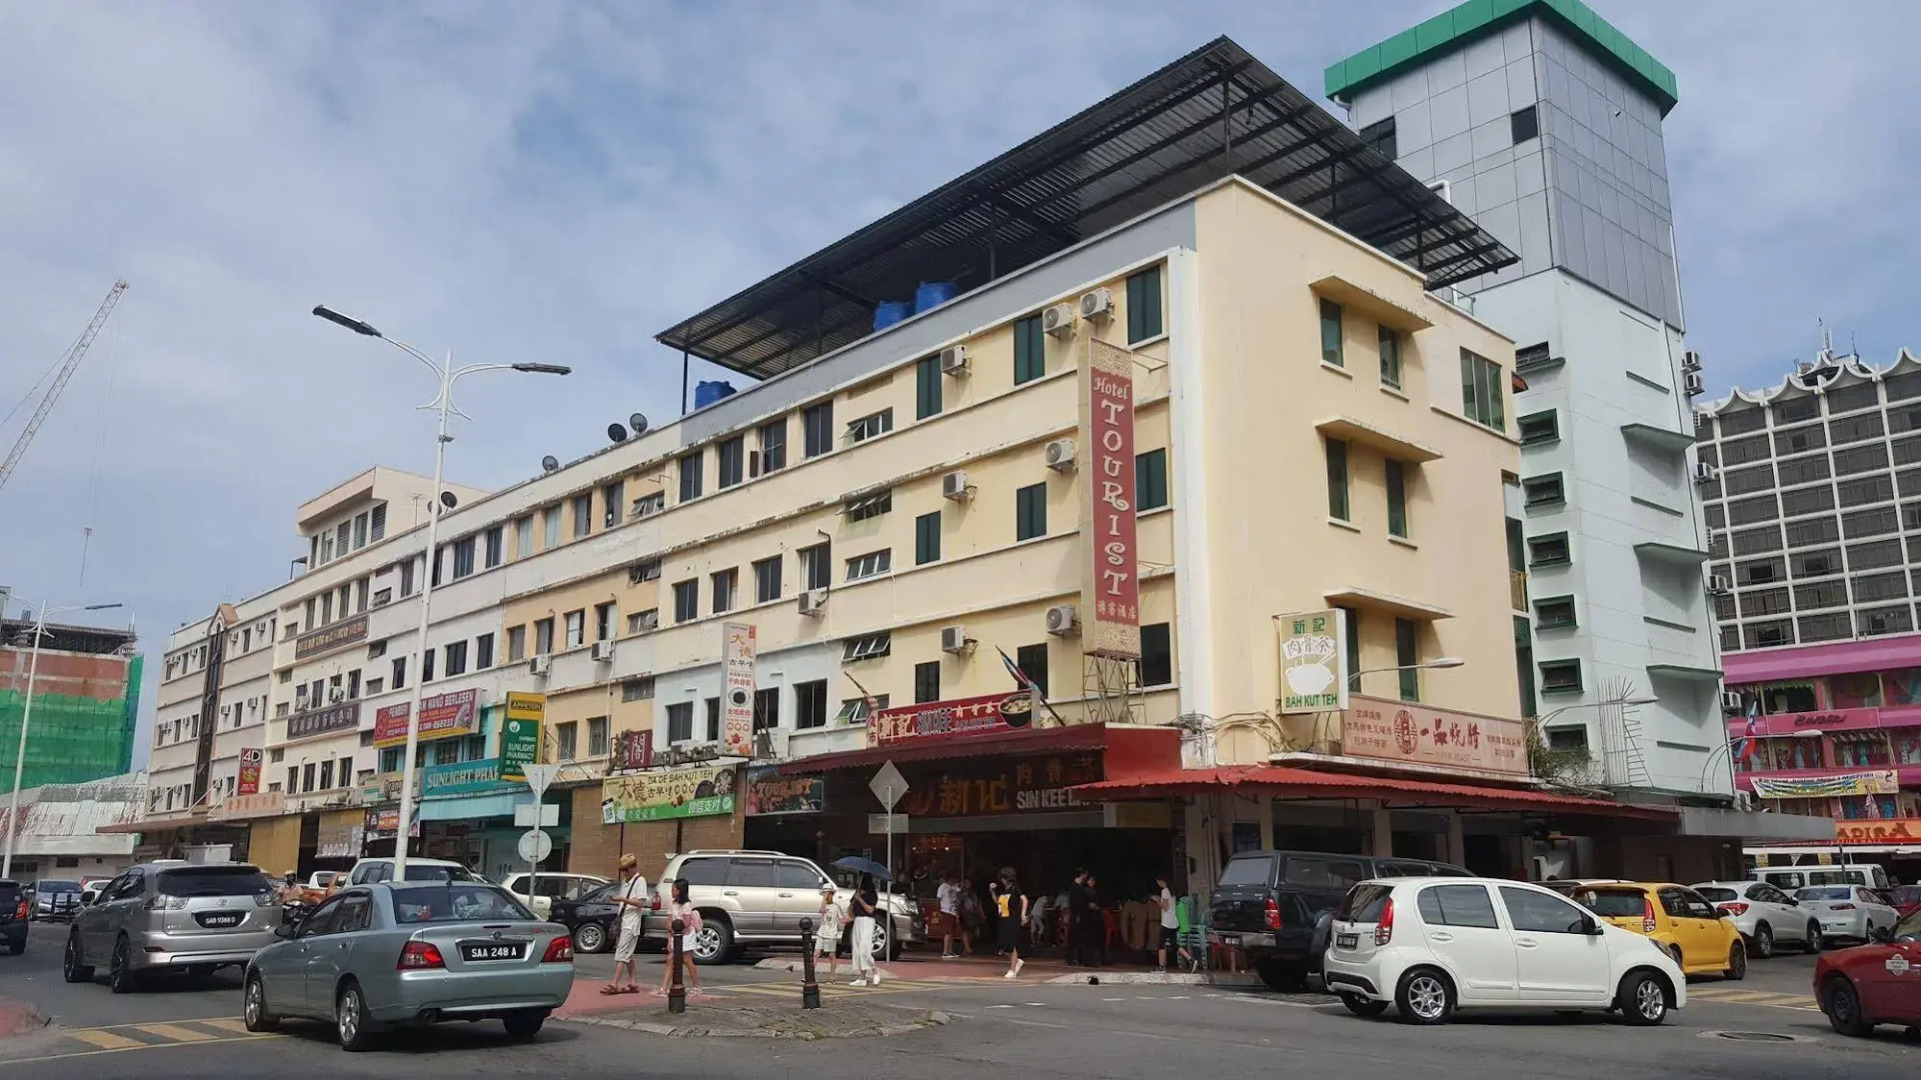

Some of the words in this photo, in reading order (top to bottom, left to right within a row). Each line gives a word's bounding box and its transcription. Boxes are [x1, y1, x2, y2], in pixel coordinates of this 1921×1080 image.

[1093, 377, 1129, 400] Hotel
[1101, 399, 1130, 596] TOURIST
[1287, 634, 1331, 656] 肉骨茶
[1286, 695, 1302, 708] BAH
[1304, 695, 1320, 707] KUT
[1321, 693, 1337, 706] TEH
[507, 743, 536, 752] SUNLIGHT
[243, 750, 261, 762] 4D
[506, 751, 534, 760] PHARMACY
[428, 769, 473, 788] SUNLIGHT
[648, 776, 657, 784] DA
[659, 775, 667, 783] DE
[670, 773, 683, 783] BAH
[685, 771, 698, 780] KUT
[700, 769, 713, 779] TEH
[618, 779, 647, 801] 大德
[647, 784, 673, 799] 古早味
[688, 798, 721, 814] 微信支付
[1017, 790, 1040, 809] SIN
[1041, 788, 1065, 808] KEE
[471, 948, 488, 957] SAA
[491, 947, 509, 957] 248
[511, 947, 517, 956] A
